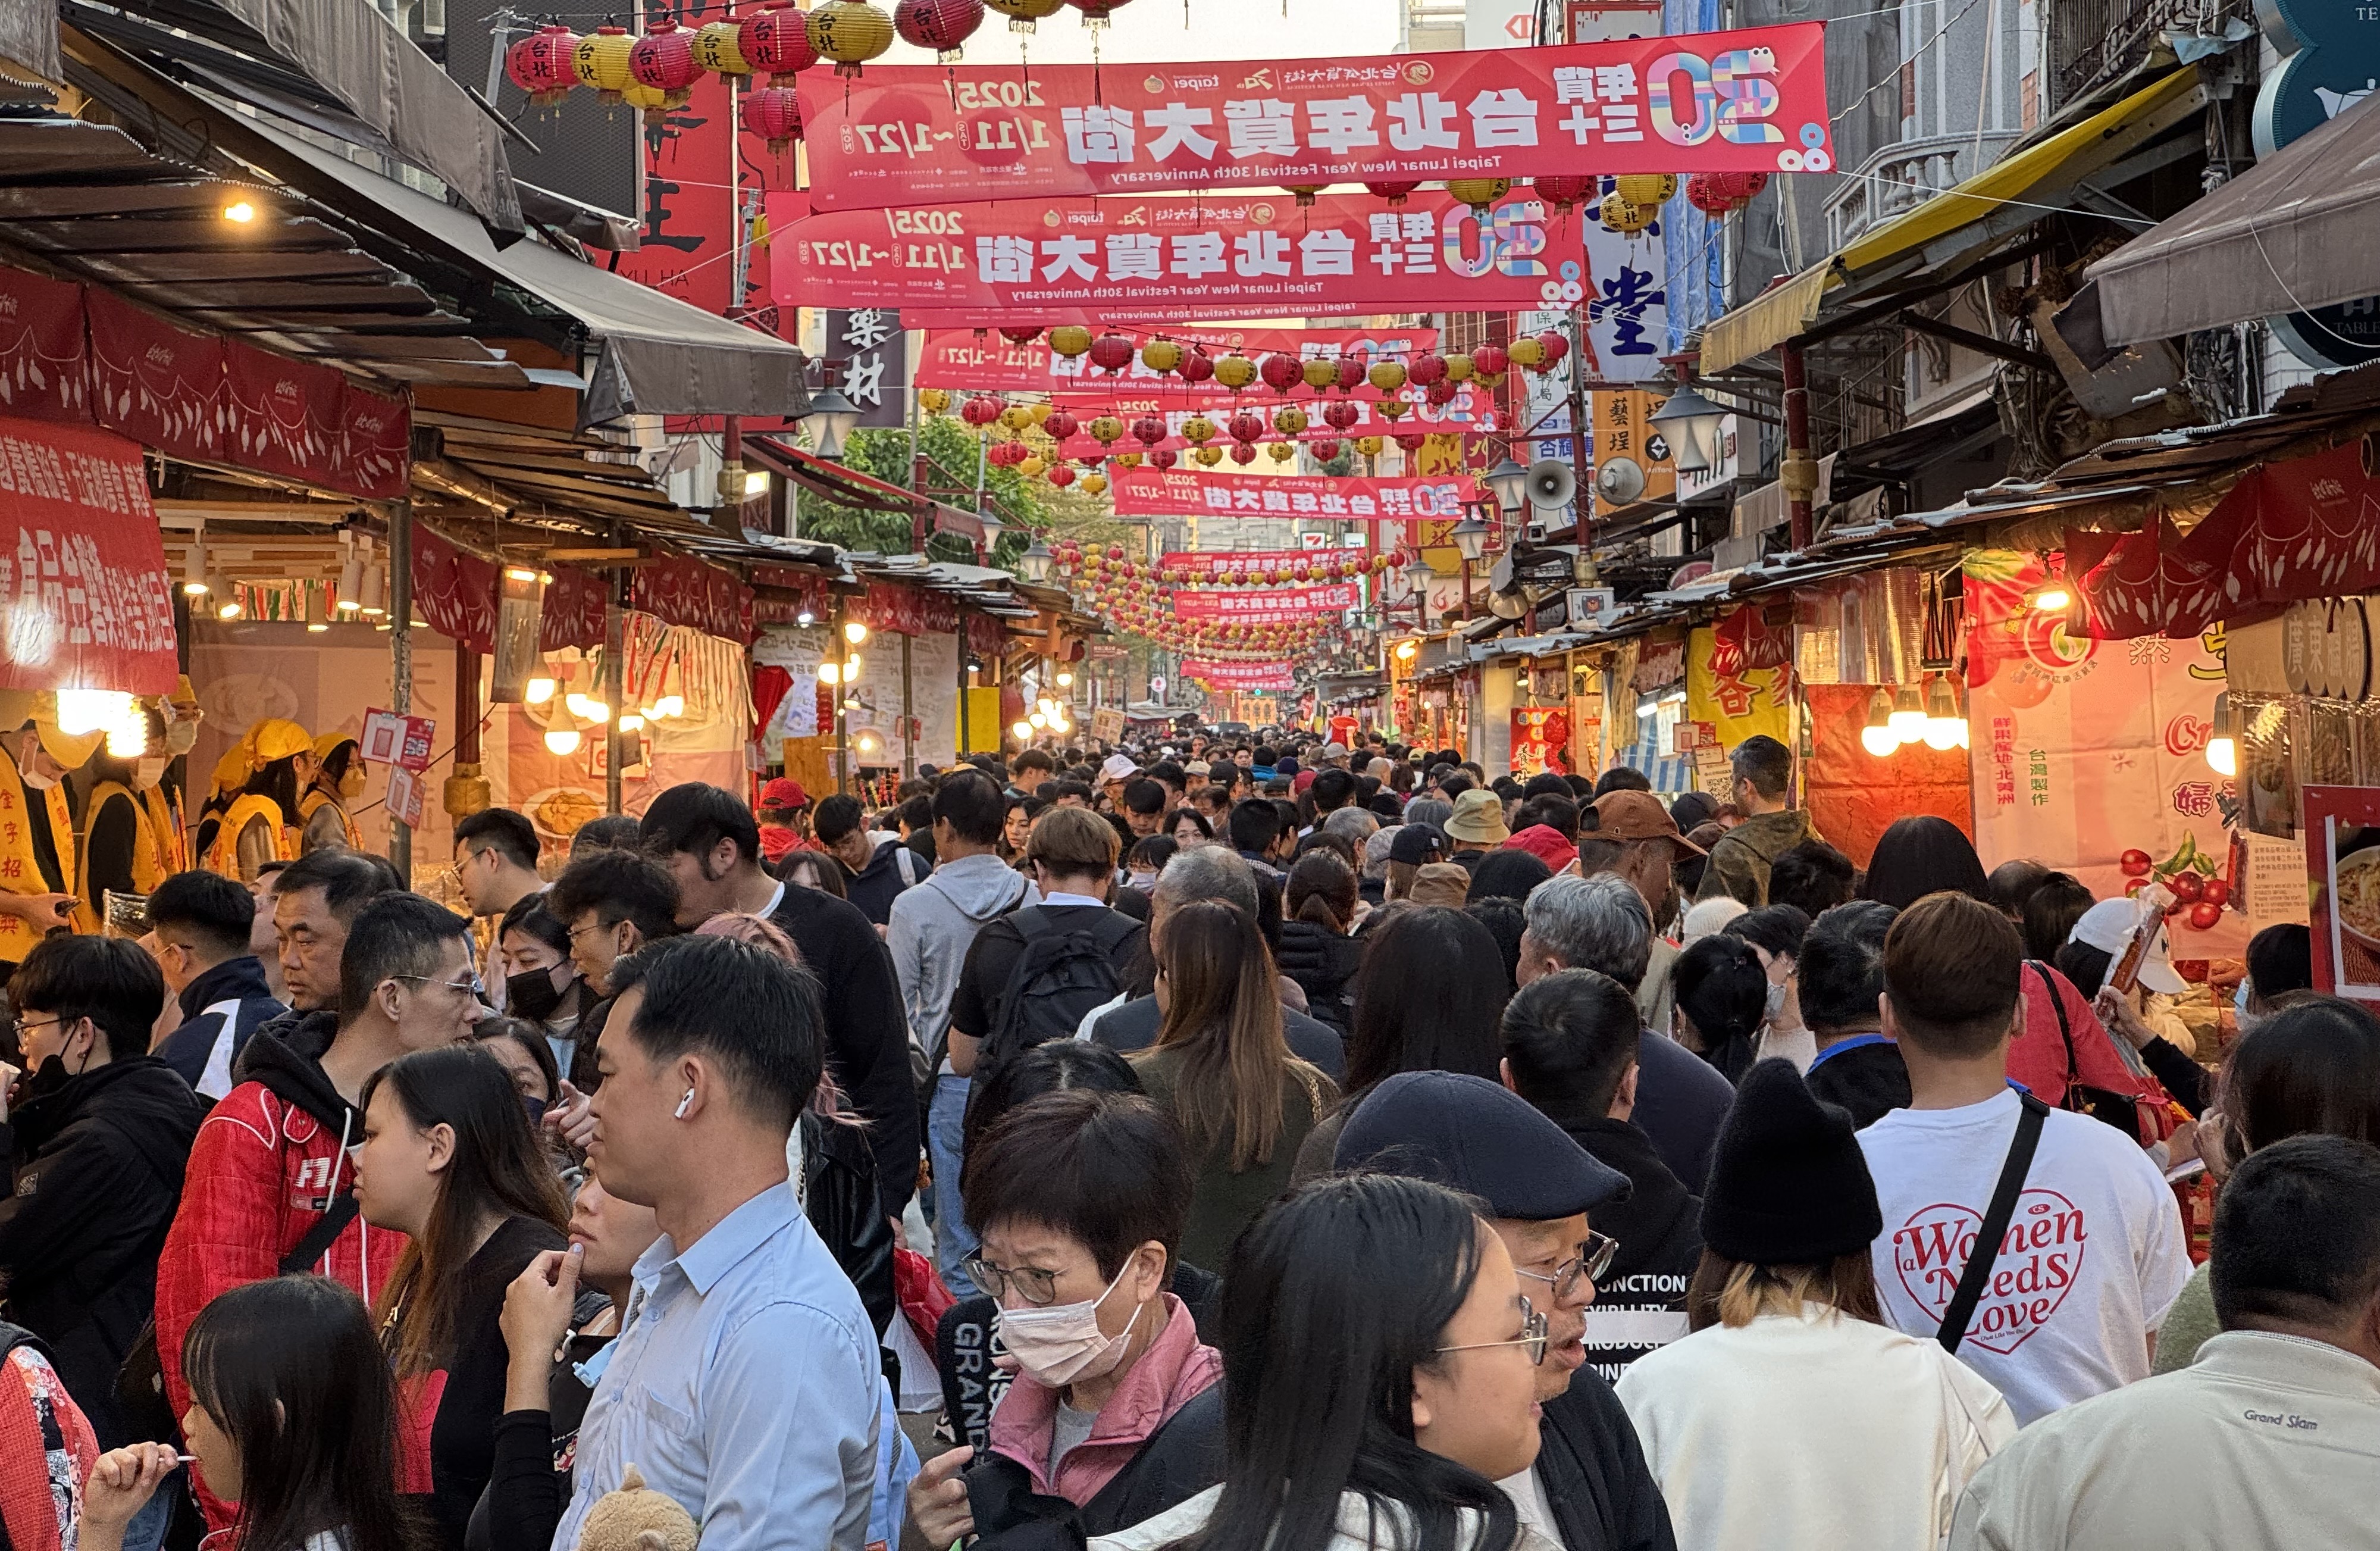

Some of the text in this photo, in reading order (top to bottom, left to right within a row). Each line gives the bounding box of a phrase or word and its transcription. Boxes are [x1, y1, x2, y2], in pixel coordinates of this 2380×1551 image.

[754, 21, 774, 64] 台北
[818, 13, 839, 52] 台北
[913, 7, 943, 43] 台北
[532, 42, 550, 77] 台北
[580, 43, 598, 81] 台北
[638, 46, 660, 83] 台北
[702, 34, 722, 67] 台北
[1535, 312, 1552, 325] 保
[1589, 266, 1665, 356] 堂
[2029, 749, 2049, 806] 台灣製作
[1903, 1255, 1916, 1271] a
[2244, 1409, 2318, 1430] Grand Slam
